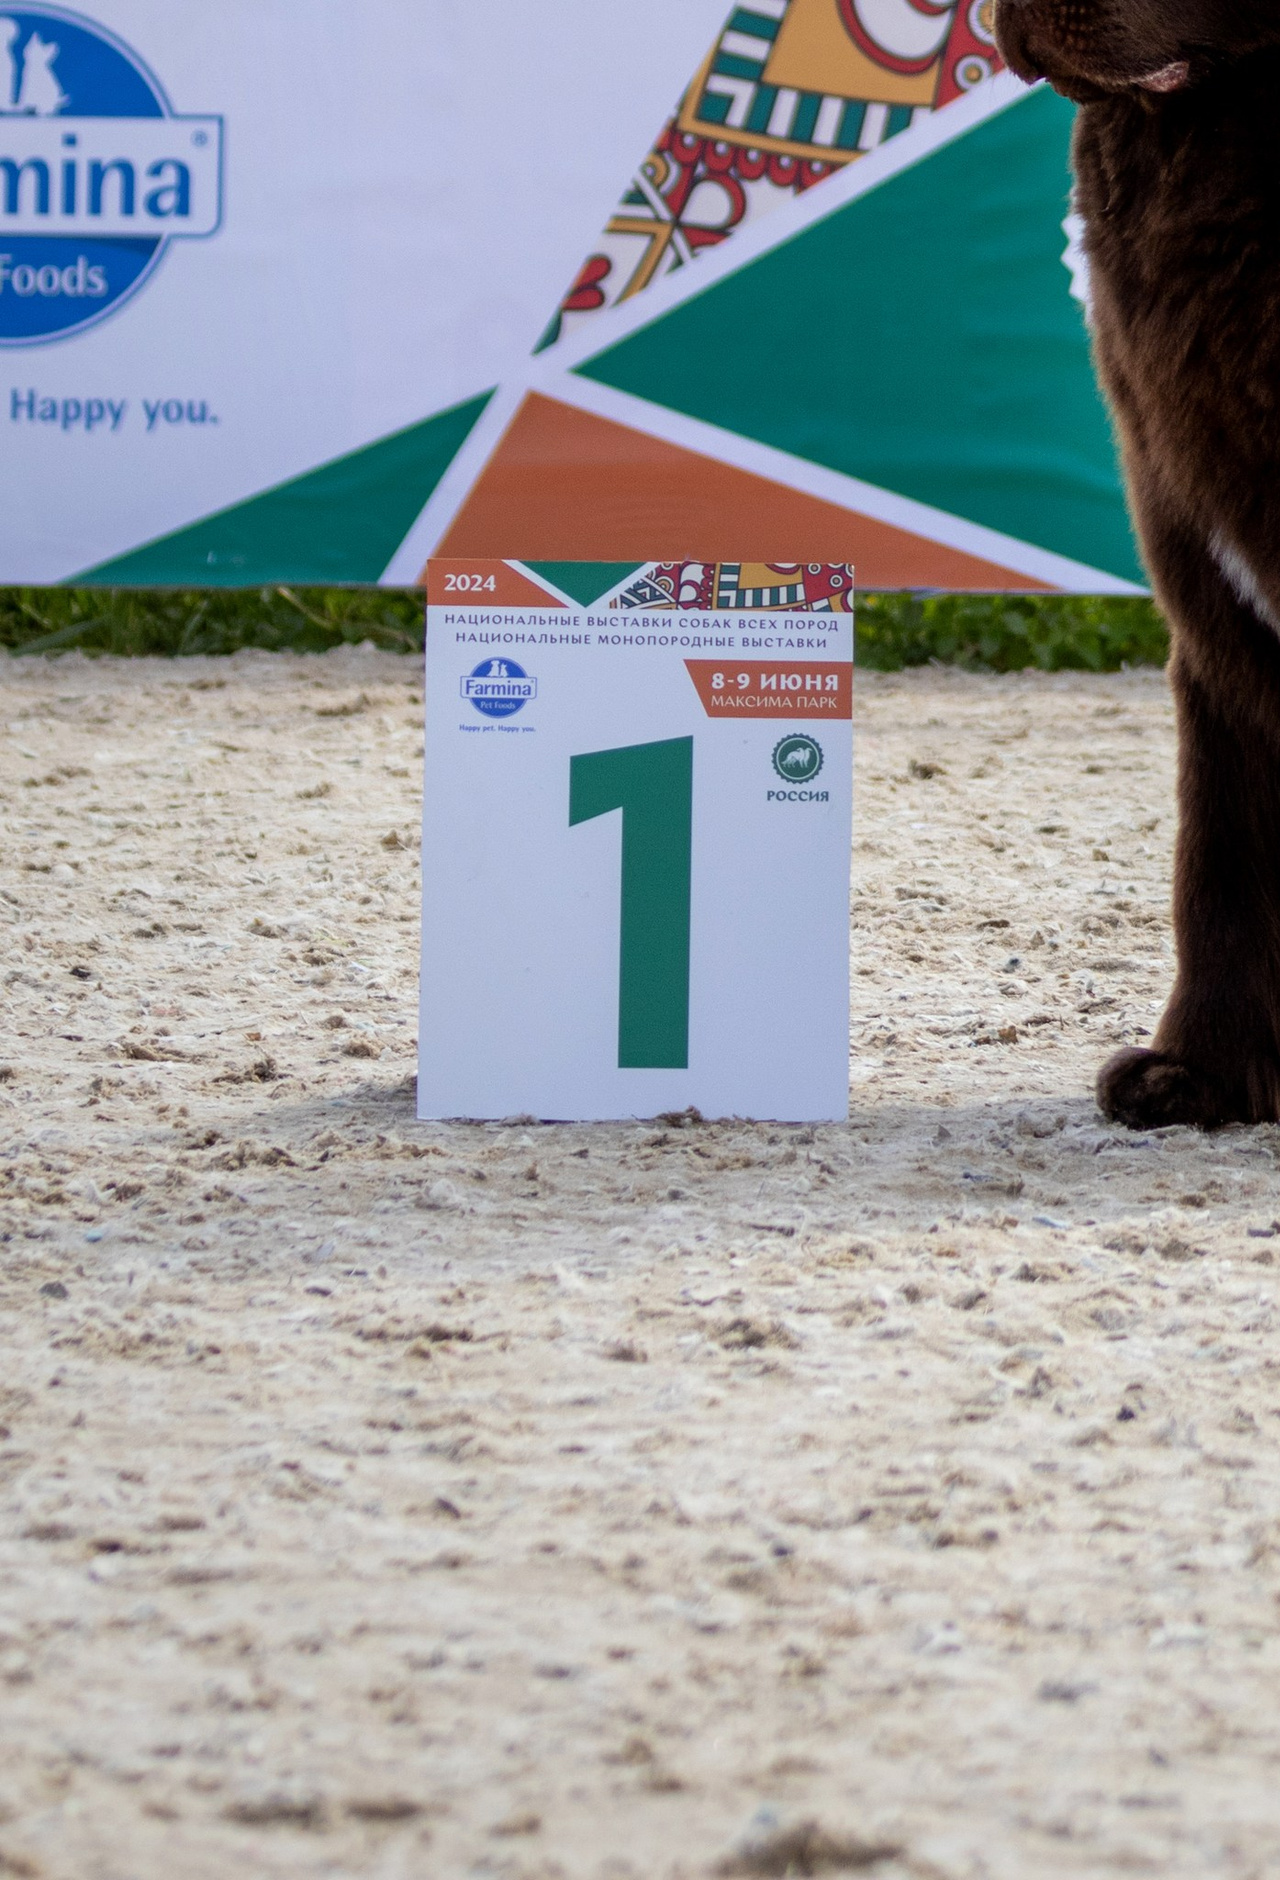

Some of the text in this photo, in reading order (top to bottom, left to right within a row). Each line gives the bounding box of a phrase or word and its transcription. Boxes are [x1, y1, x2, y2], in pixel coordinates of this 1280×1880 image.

[9, 387, 220, 432] Happy you.
[444, 574, 497, 592] 2024
[444, 614, 839, 632] НАЦИОНАЛЬНЫЕ ВЫСТАВКИ СОБАК ВСЕХ ПОРОД
[456, 632, 828, 649] НАЦИОНАЛЬНЫЕ МОНОПОРОДНЫЕ ВЫСТАВКИ
[465, 680, 532, 697] Farmina
[711, 672, 838, 691] 8-9 ИЮНЯ
[480, 701, 516, 710] Pet Foods
[711, 695, 837, 709] МАКСИМА ПАРК
[459, 724, 481, 733] Happy
[498, 724, 520, 733] Happy
[766, 790, 829, 802] РОССИЯ
[569, 735, 693, 1069] 1
